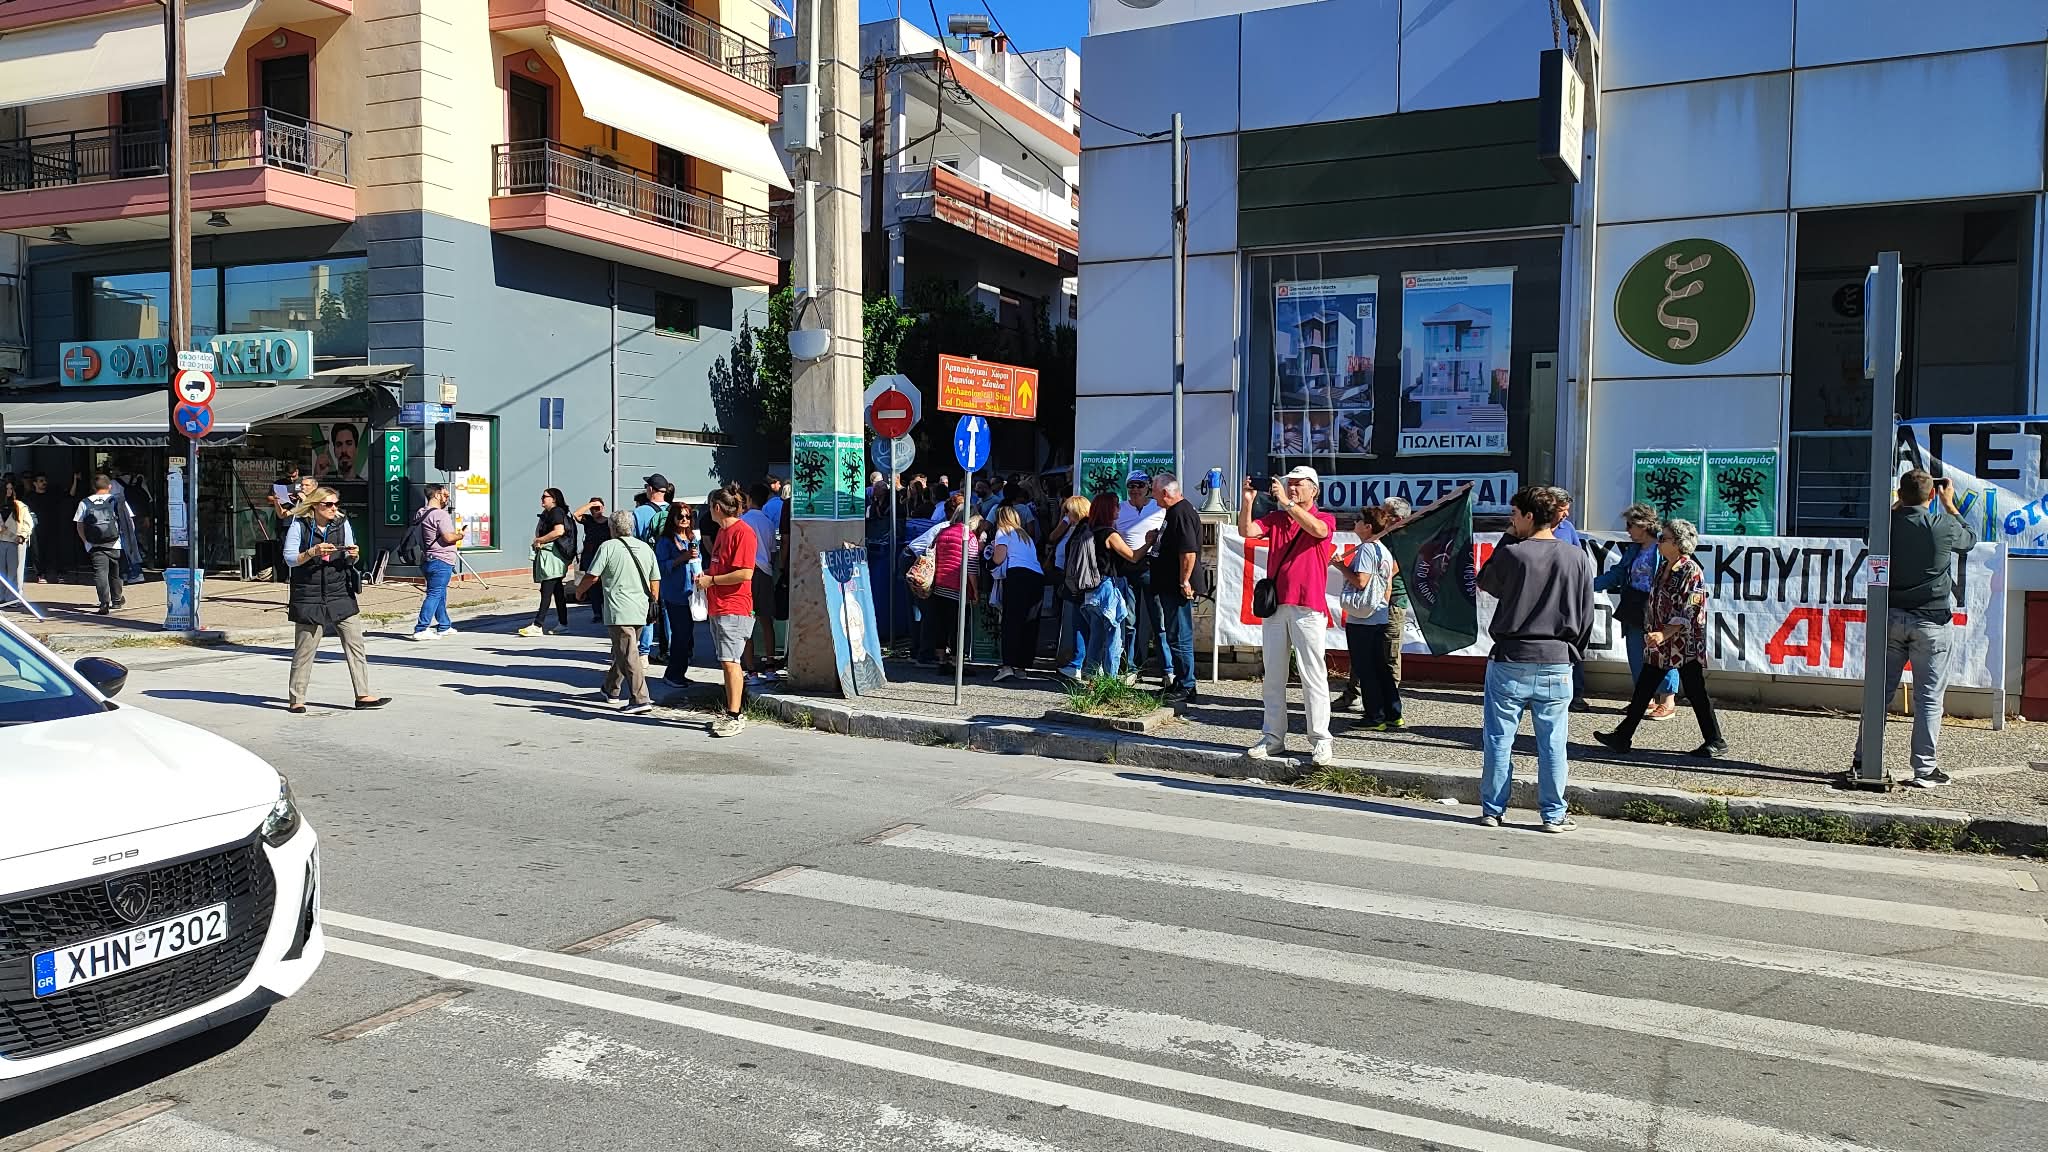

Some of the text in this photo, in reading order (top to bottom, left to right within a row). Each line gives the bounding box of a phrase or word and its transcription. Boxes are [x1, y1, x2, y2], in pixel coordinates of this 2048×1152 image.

[109, 338, 297, 377] ΦΑΡΑΚΕΙΟ
[1403, 435, 1481, 448] ΠΩΛΕΙΤΑΙ
[1637, 456, 1700, 465] αποκλεισμός!
[1708, 456, 1775, 465] αποκλεισμός!
[389, 434, 400, 521] ΦΑΡΜΑΚΕΙΟ
[1319, 480, 1507, 506] ΟΙΚΙΑΖΕΑΙ
[92, 848, 139, 866] 208
[68, 910, 221, 983] XHN-7302
[38, 976, 53, 988] GR
